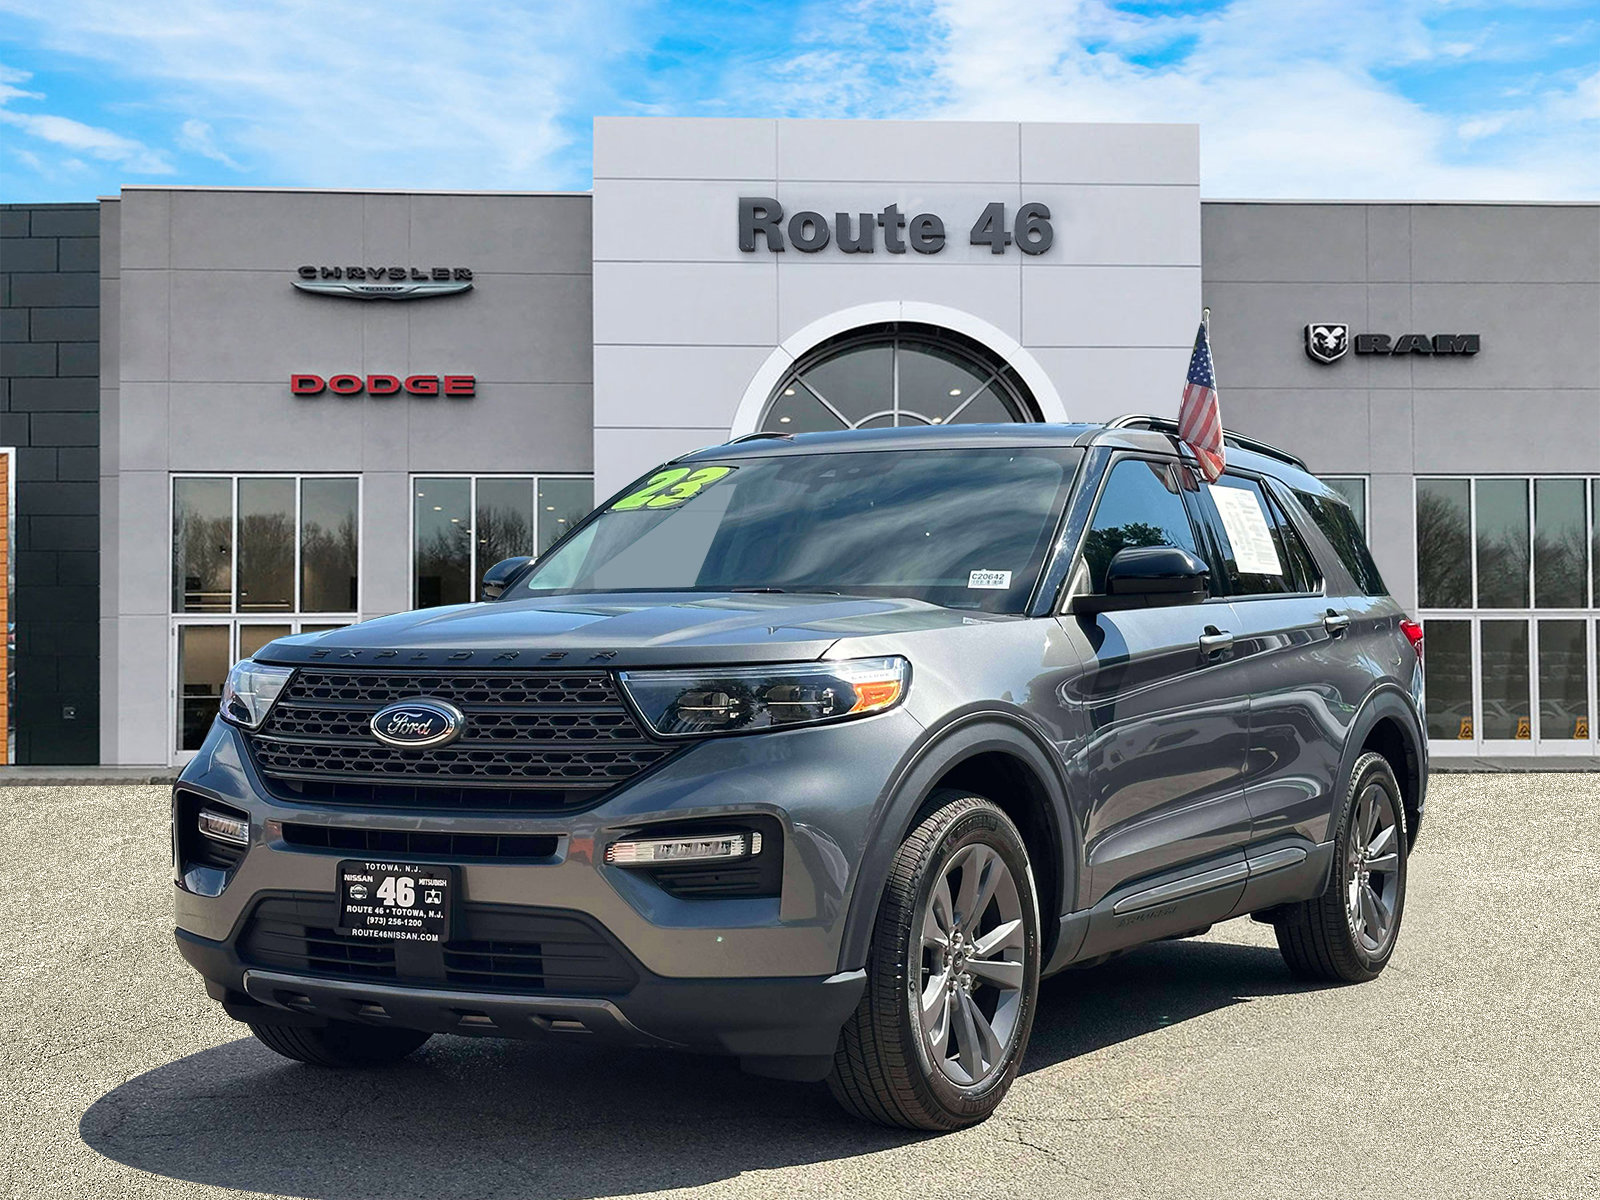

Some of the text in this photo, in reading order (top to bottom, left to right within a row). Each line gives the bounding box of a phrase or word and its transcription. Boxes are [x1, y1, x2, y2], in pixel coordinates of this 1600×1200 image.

[738, 196, 1054, 256] Route 46
[297, 265, 473, 280] CHRYSLER
[1354, 334, 1480, 357] RAM
[290, 374, 476, 397] DODGE
[610, 466, 732, 511] 23
[308, 648, 619, 661] EXPLORER
[387, 711, 433, 735] Ford
[405, 865, 421, 873] N.J.
[344, 874, 374, 883] NISSAN
[376, 876, 416, 908] 46
[346, 905, 444, 919] ROUTE 46 TOTOWA, N.J.
[366, 916, 423, 927] (973) 256-1200
[351, 928, 439, 942] ROUTE46NISSAN.COM
